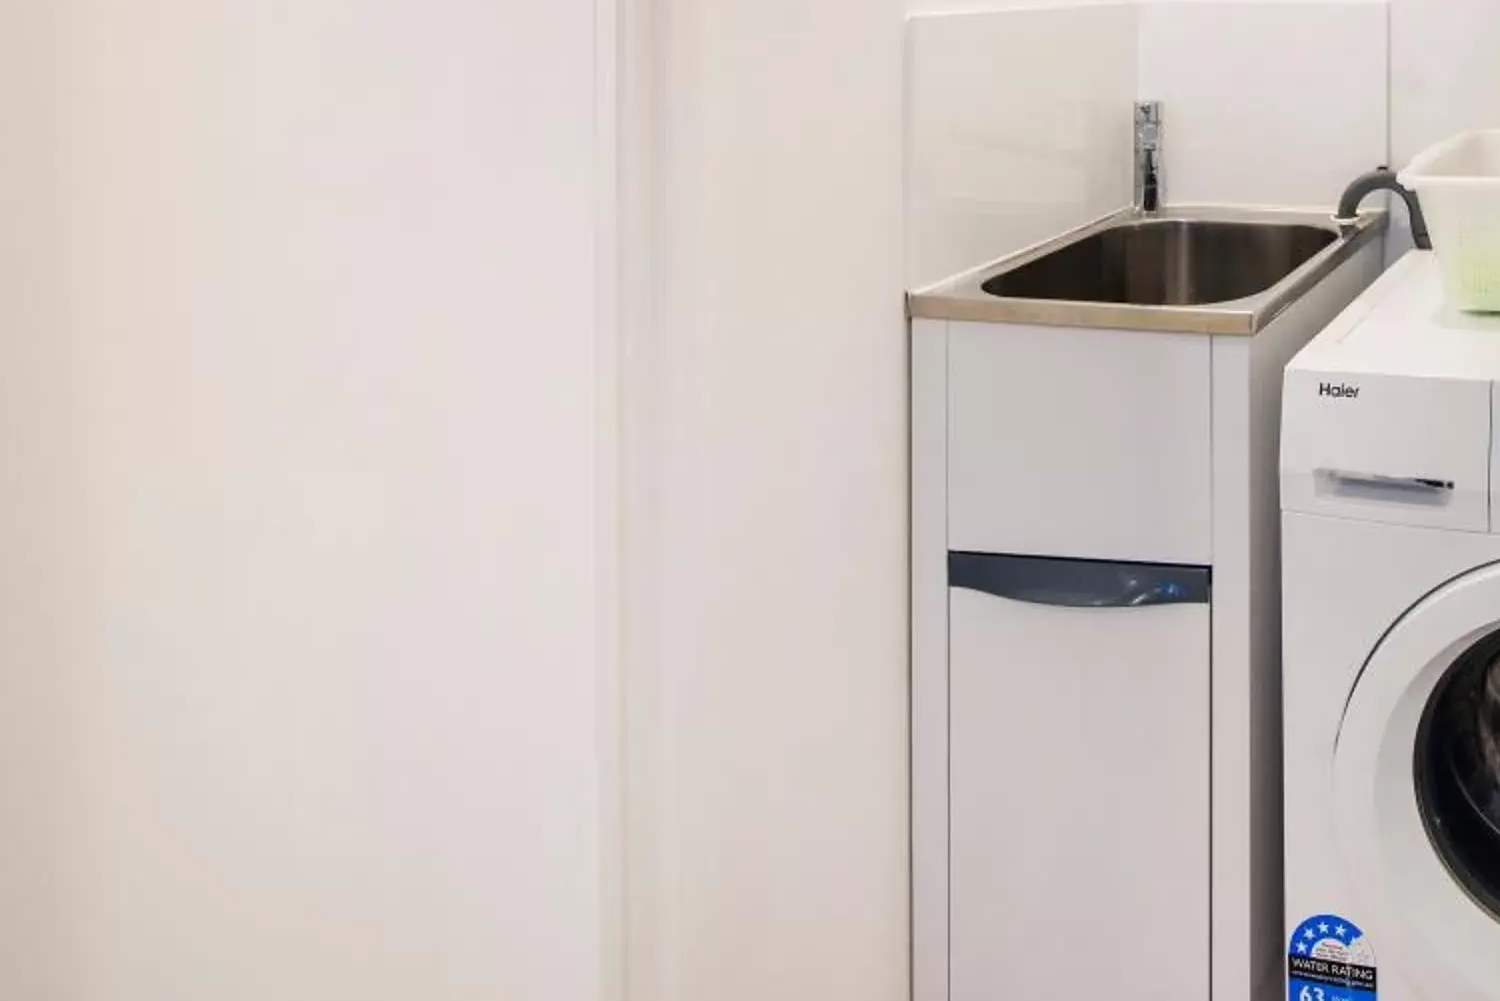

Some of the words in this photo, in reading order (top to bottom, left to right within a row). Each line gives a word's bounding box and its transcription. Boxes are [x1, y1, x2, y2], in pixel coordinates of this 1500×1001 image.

[1319, 382, 1360, 398] Haier
[1291, 958, 1329, 972] WATER
[1332, 965, 1373, 980] RATING
